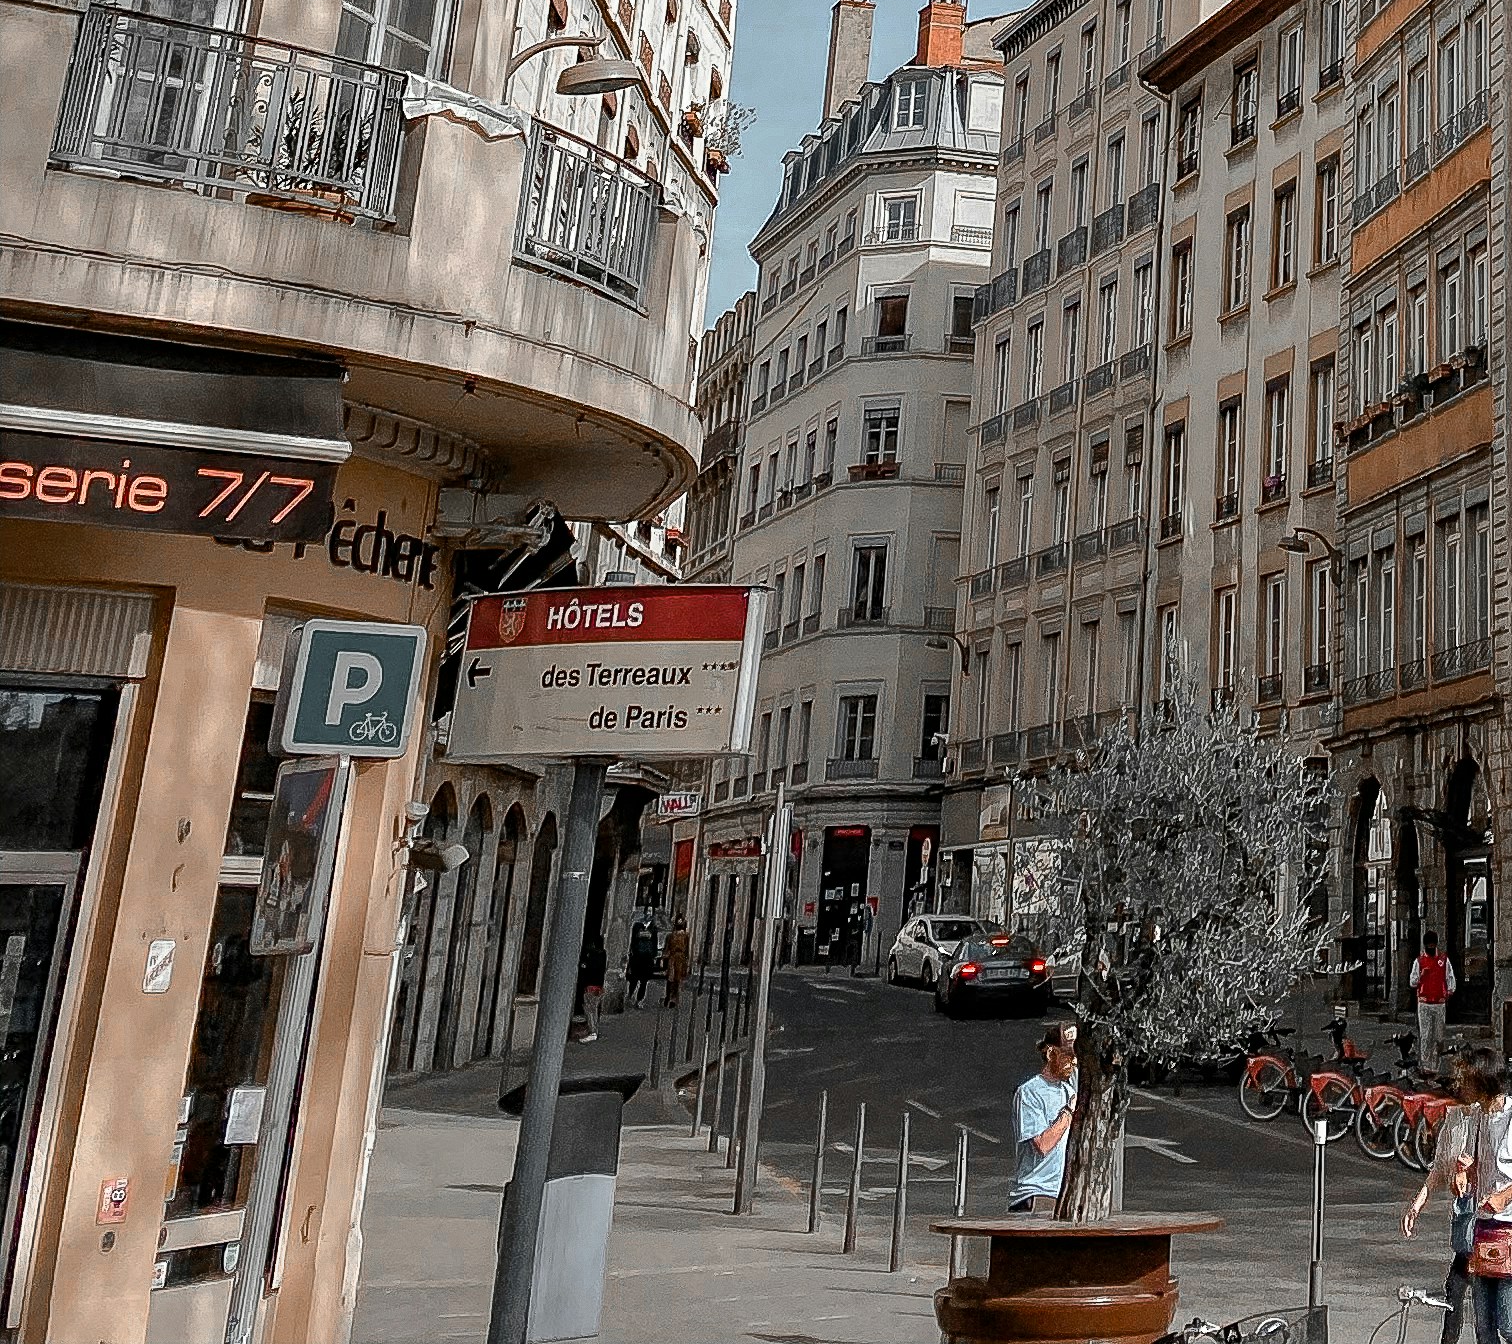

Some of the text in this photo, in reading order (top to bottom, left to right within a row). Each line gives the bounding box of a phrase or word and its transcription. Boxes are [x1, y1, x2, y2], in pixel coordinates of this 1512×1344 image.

[198, 468, 314, 524] 7/7
[547, 598, 644, 629] HÔTELS
[325, 651, 382, 725] P
[541, 662, 693, 688] des Terreaux
[589, 705, 688, 730] de Paris
